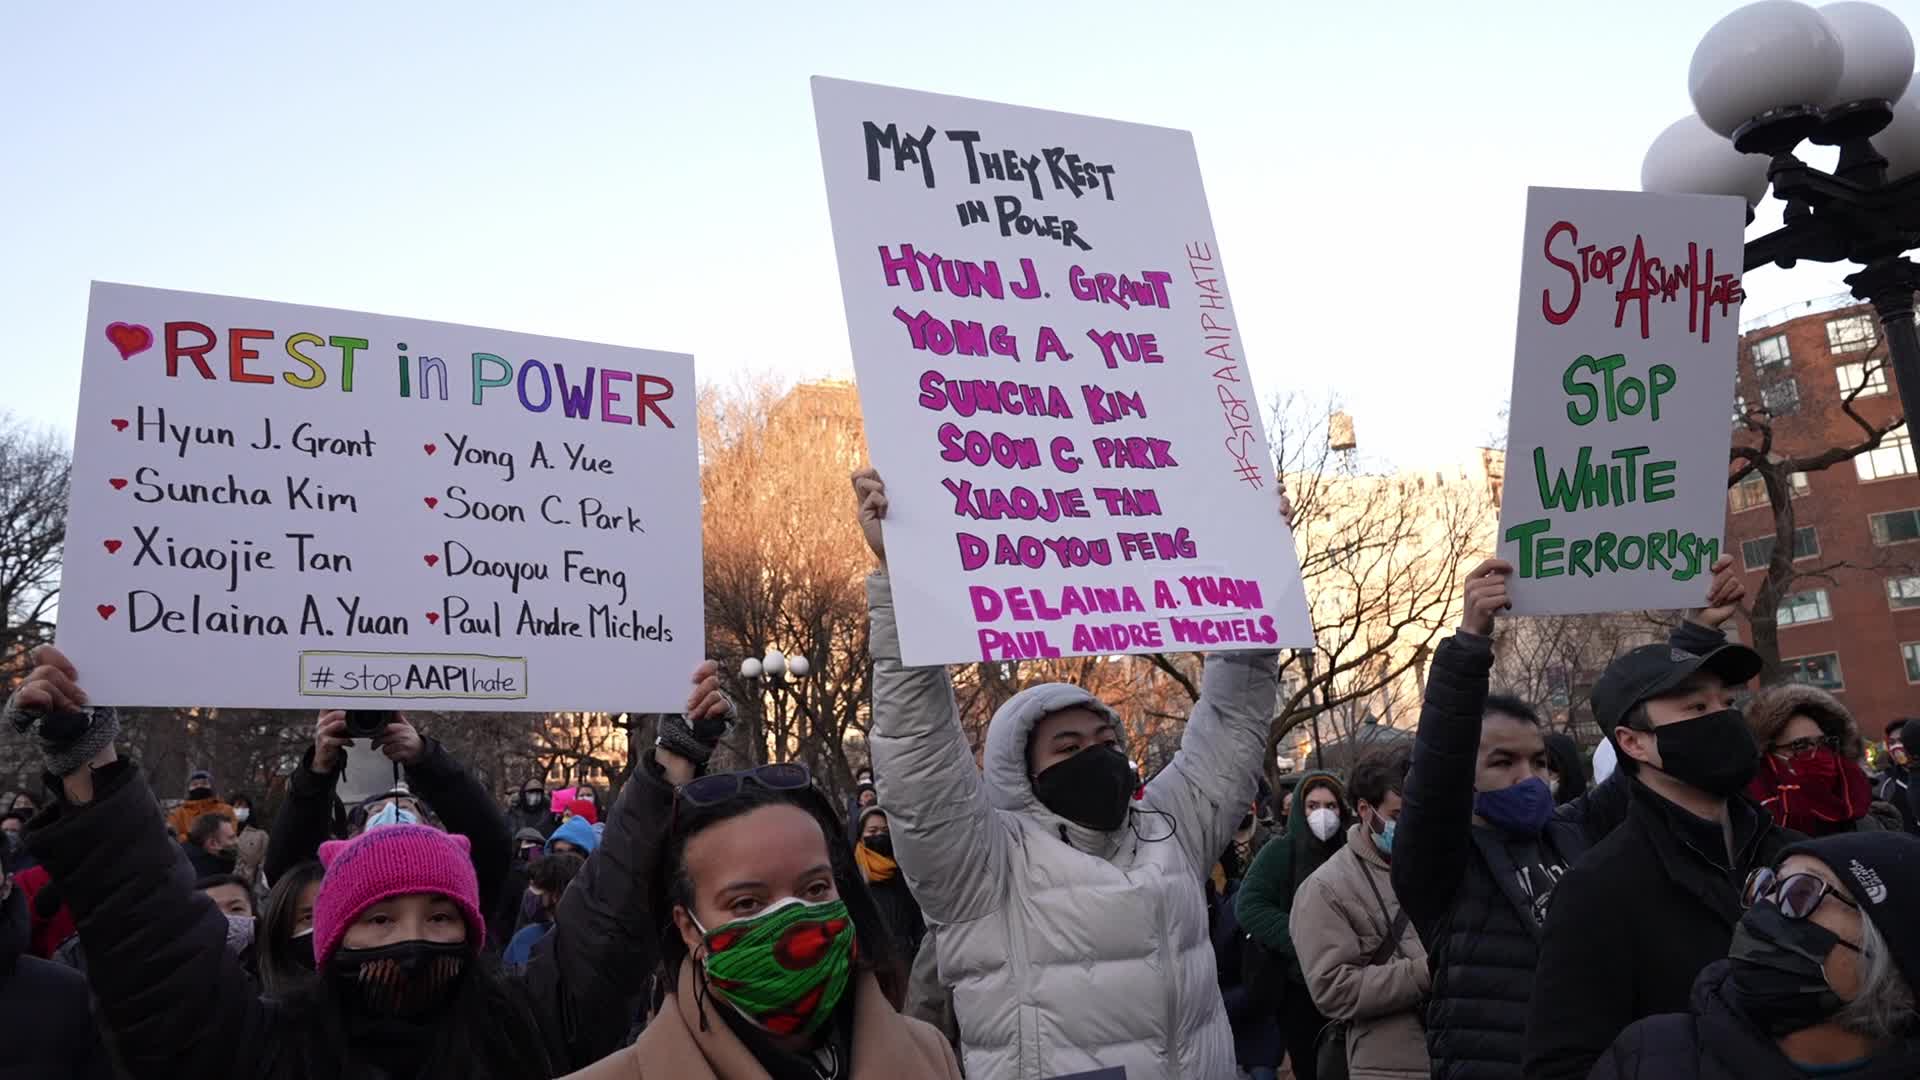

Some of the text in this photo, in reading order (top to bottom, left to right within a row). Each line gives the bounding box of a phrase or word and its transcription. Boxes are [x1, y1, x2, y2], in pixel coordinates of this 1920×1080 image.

[863, 121, 1115, 200] MAY THEY REST
[956, 196, 1092, 250] IN POWER
[878, 244, 1172, 310] HYUN J. GRANT
[1543, 221, 1743, 343] STOP ASIAN HATE
[893, 307, 1163, 368] YONG A. YUE
[164, 321, 676, 428] REST in POWER
[919, 370, 1146, 424] SUNCHA KIM
[1563, 353, 1676, 425] STOP
[137, 407, 376, 457] Hyun J. Grant
[444, 433, 613, 482] Yong A. Yue
[938, 423, 1178, 473] SOON C. PARK
[134, 467, 357, 512] Suncha Kim
[941, 479, 1161, 522] XIAOJIE TAN
[1533, 446, 1676, 512] WHITE
[444, 486, 645, 533] Soon C. Park
[133, 525, 352, 591] Xiaojie Tan
[444, 541, 626, 605] Daoyou Feng
[957, 528, 1196, 570] DAOYOU FENG
[1506, 519, 1718, 580] TERRORISM
[127, 589, 409, 636] Delaina A. Yuan
[443, 596, 673, 642] Paul Andre Michels
[969, 576, 1263, 622] DELAINA A. YUAN
[977, 628, 1060, 661] PAUL
[1072, 621, 1163, 651] ANDRE
